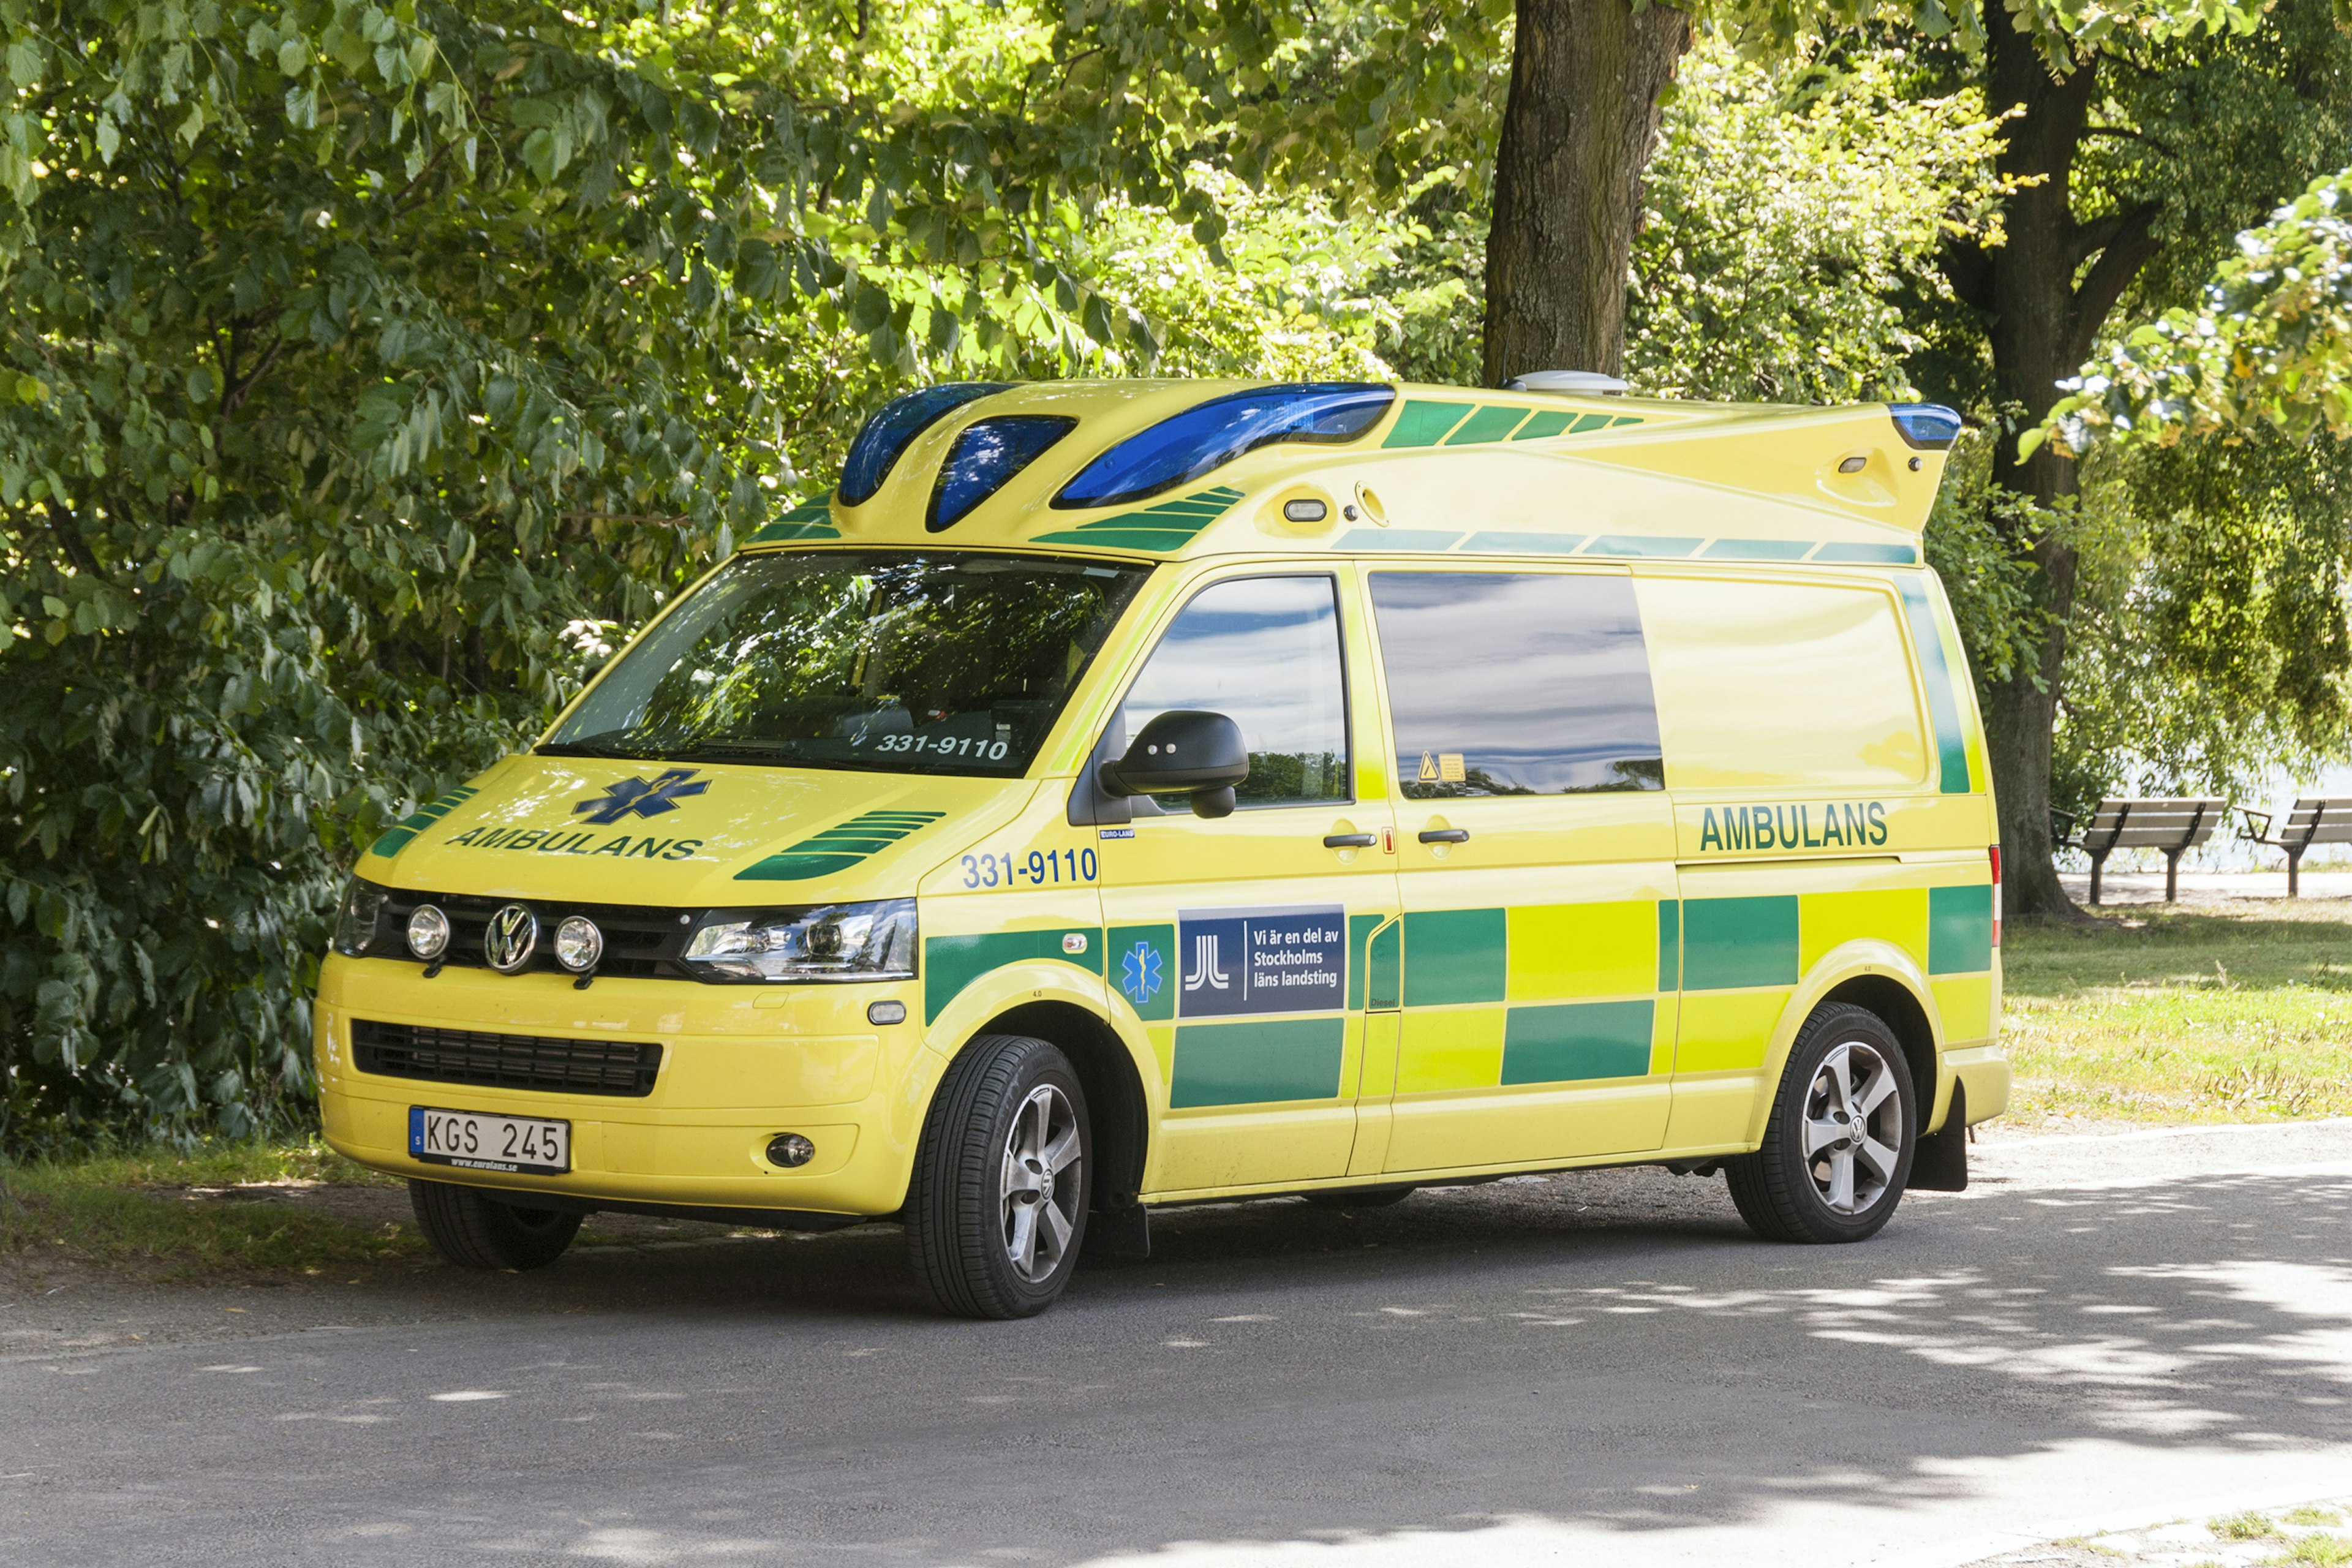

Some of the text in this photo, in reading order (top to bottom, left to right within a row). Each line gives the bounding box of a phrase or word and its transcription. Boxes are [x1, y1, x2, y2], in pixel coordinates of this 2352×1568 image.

[877, 734, 1008, 760] 331-9110
[1700, 801, 1887, 851] AMBULANS
[445, 827, 703, 861] AMBULANS
[961, 848, 1098, 888] 331-9110
[1253, 927, 1339, 946] Vi är en del av
[1254, 949, 1323, 967] Stockholms
[1254, 969, 1337, 988] läns landsting
[1371, 998, 1395, 1006] Diesel
[428, 1115, 559, 1161] KGS 245
[451, 1158, 518, 1172] www.eurolans.se
